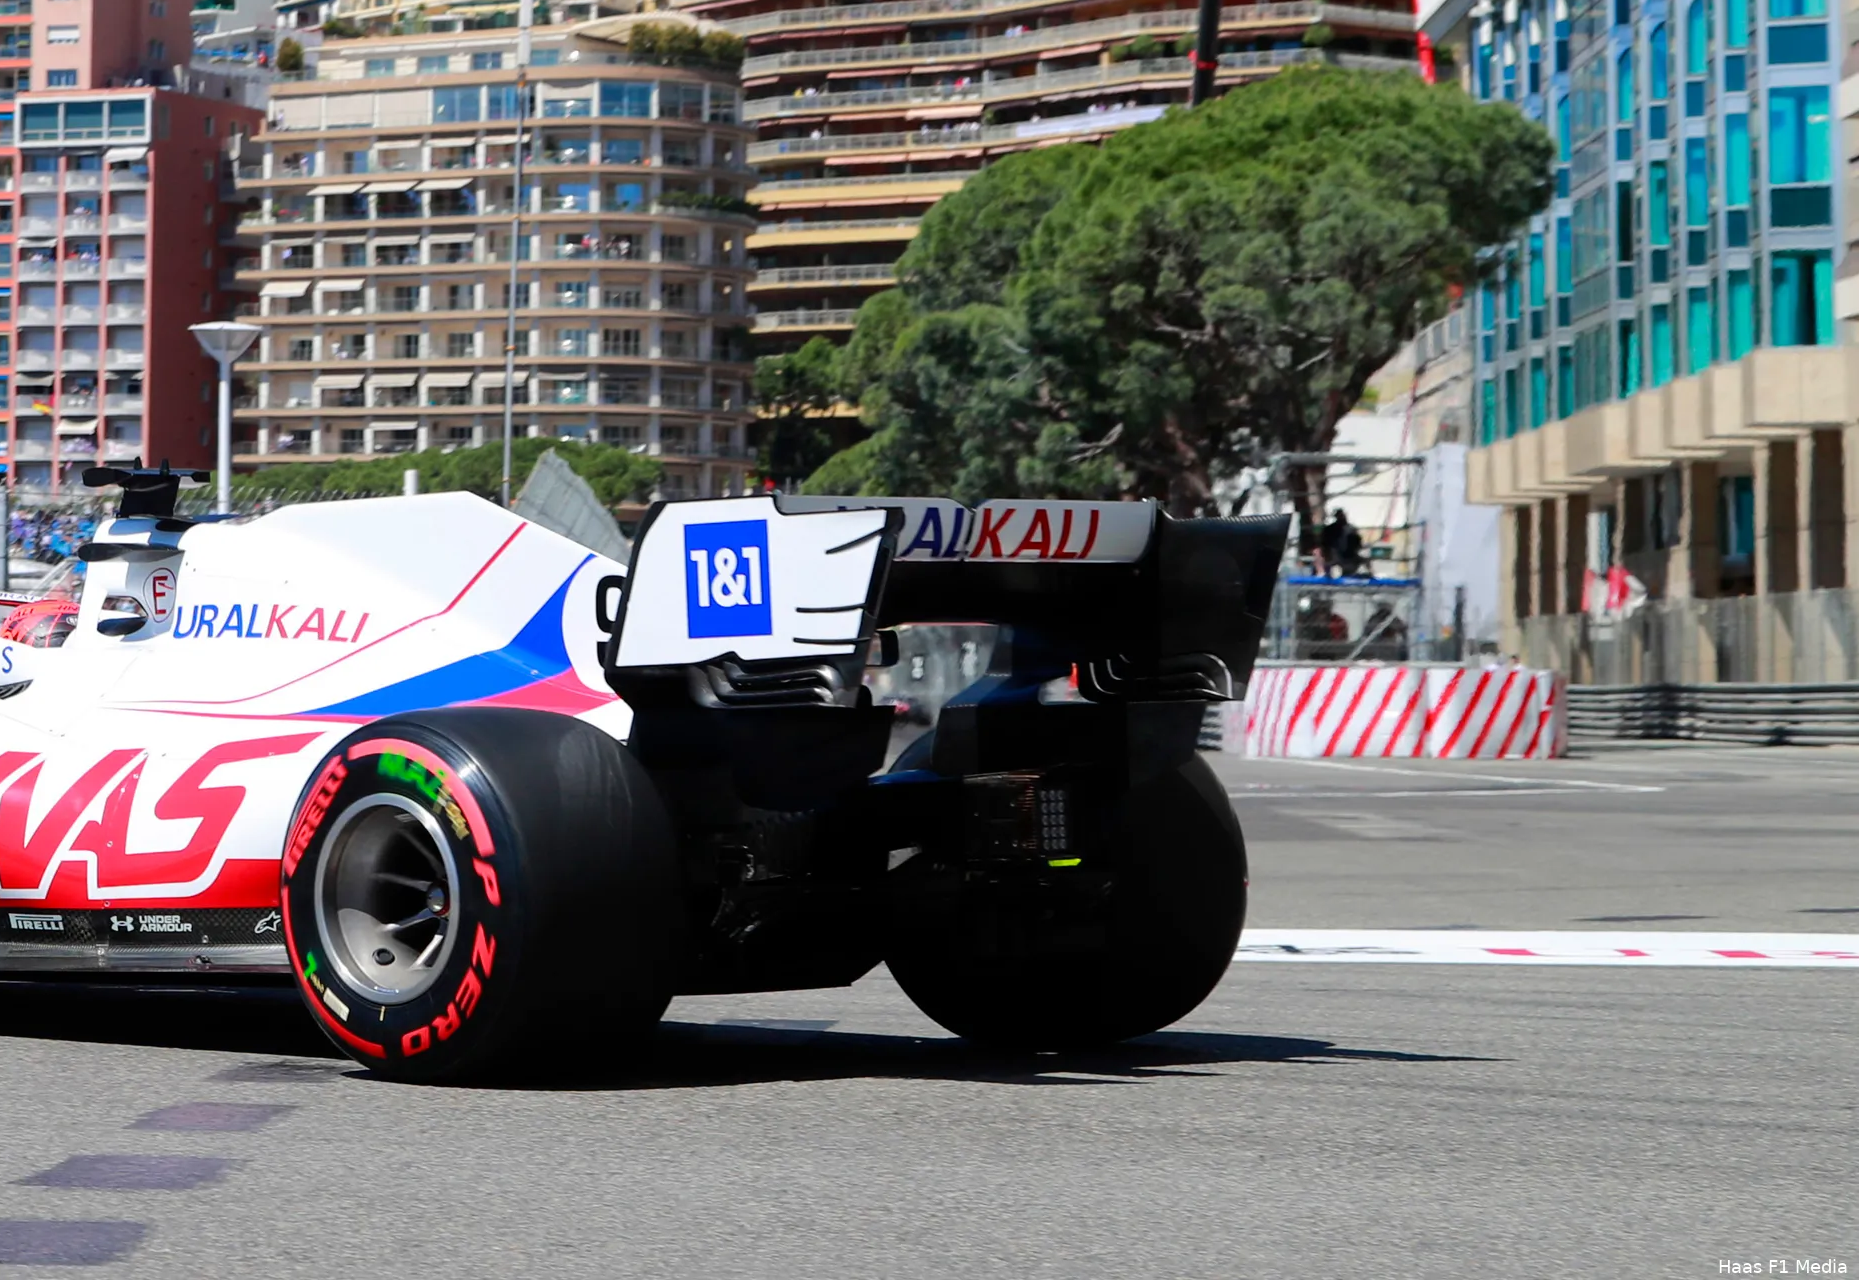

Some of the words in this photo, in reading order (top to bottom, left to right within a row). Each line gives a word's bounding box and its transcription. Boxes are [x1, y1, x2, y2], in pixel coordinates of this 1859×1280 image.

[838, 506, 1100, 558] ALKALI
[690, 547, 763, 607] 1&1
[173, 604, 370, 643] URALKALI
[283, 754, 349, 878] PIRELLI
[472, 856, 501, 907] P
[8, 913, 65, 931] PIRELLI
[139, 915, 180, 924] UNDER
[139, 923, 193, 932] ARMOUR
[401, 921, 497, 1057] ZERO
